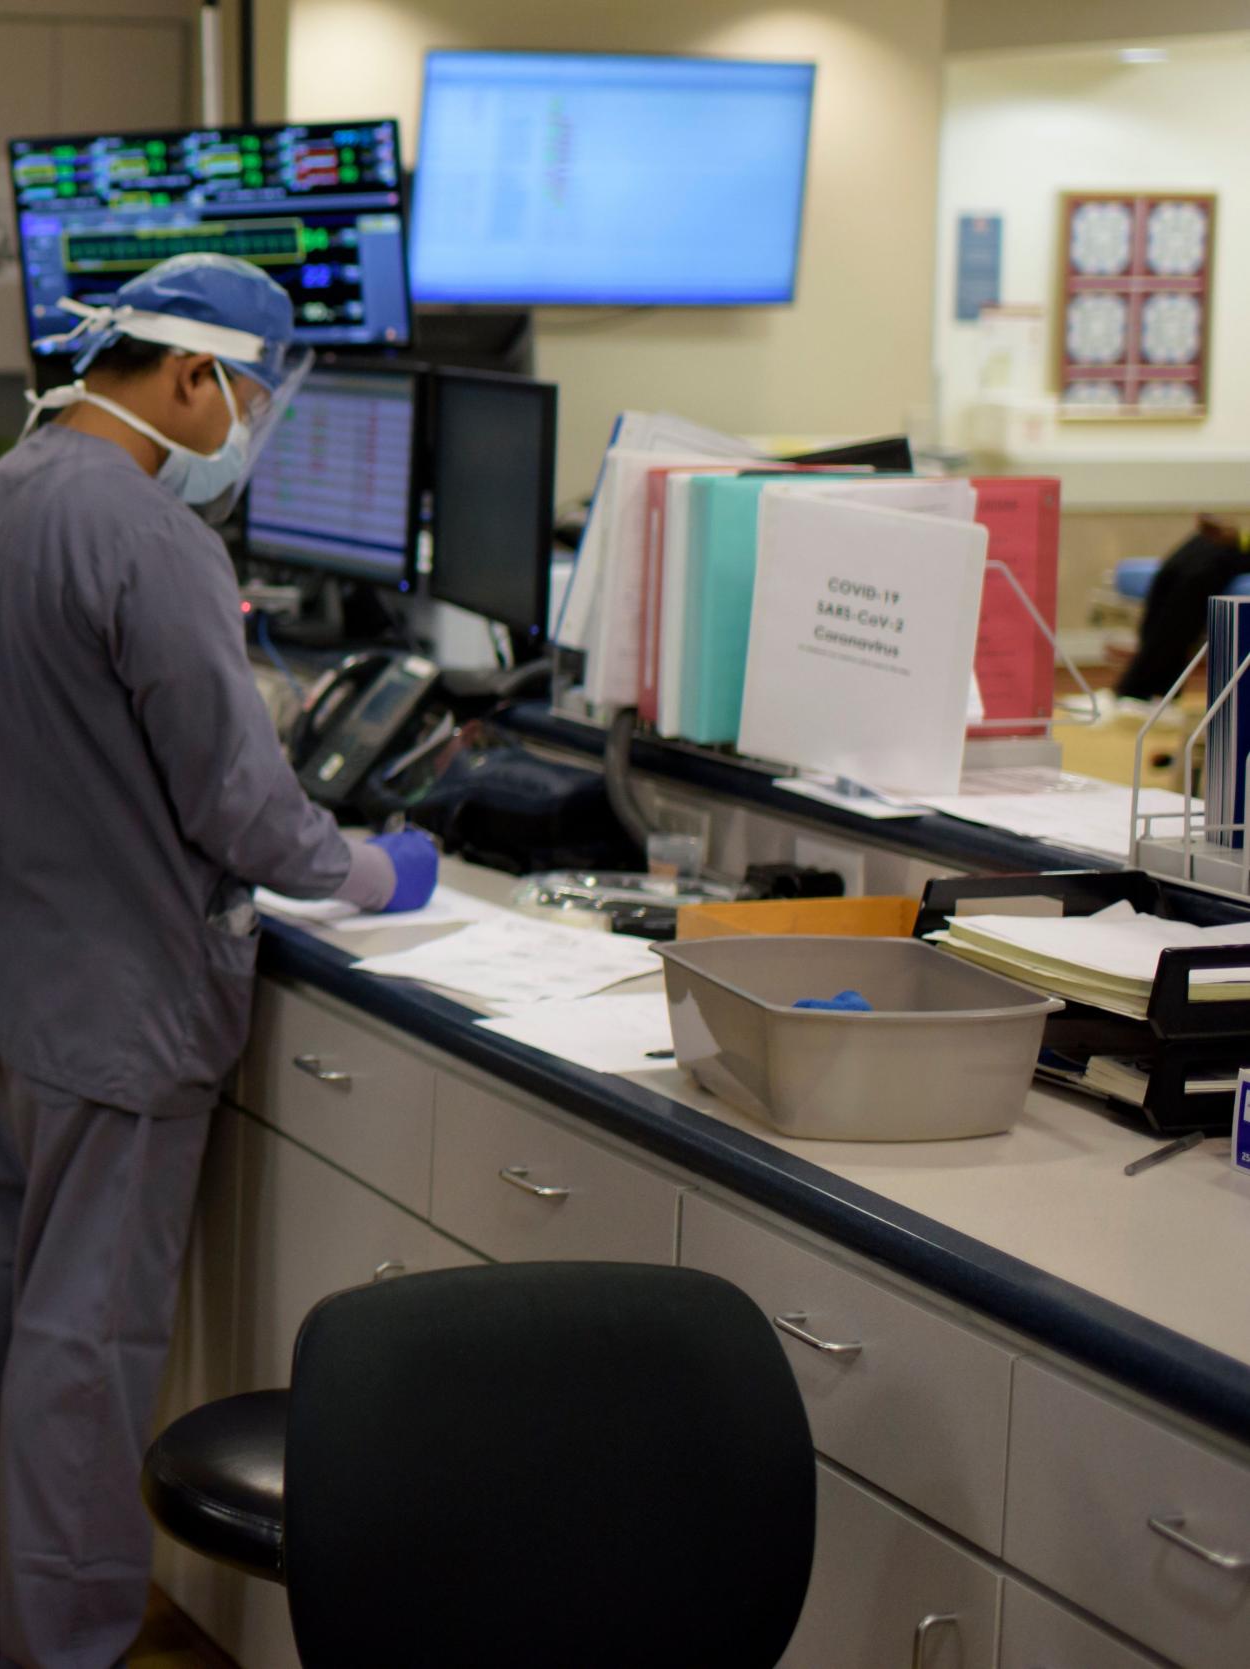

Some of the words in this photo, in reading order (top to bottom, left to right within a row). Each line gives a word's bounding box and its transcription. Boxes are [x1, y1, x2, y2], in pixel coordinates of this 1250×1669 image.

[828, 577, 900, 604] COVID-19
[816, 600, 904, 633] SARS-CoV-2
[814, 625, 899, 657] Coronavirus
